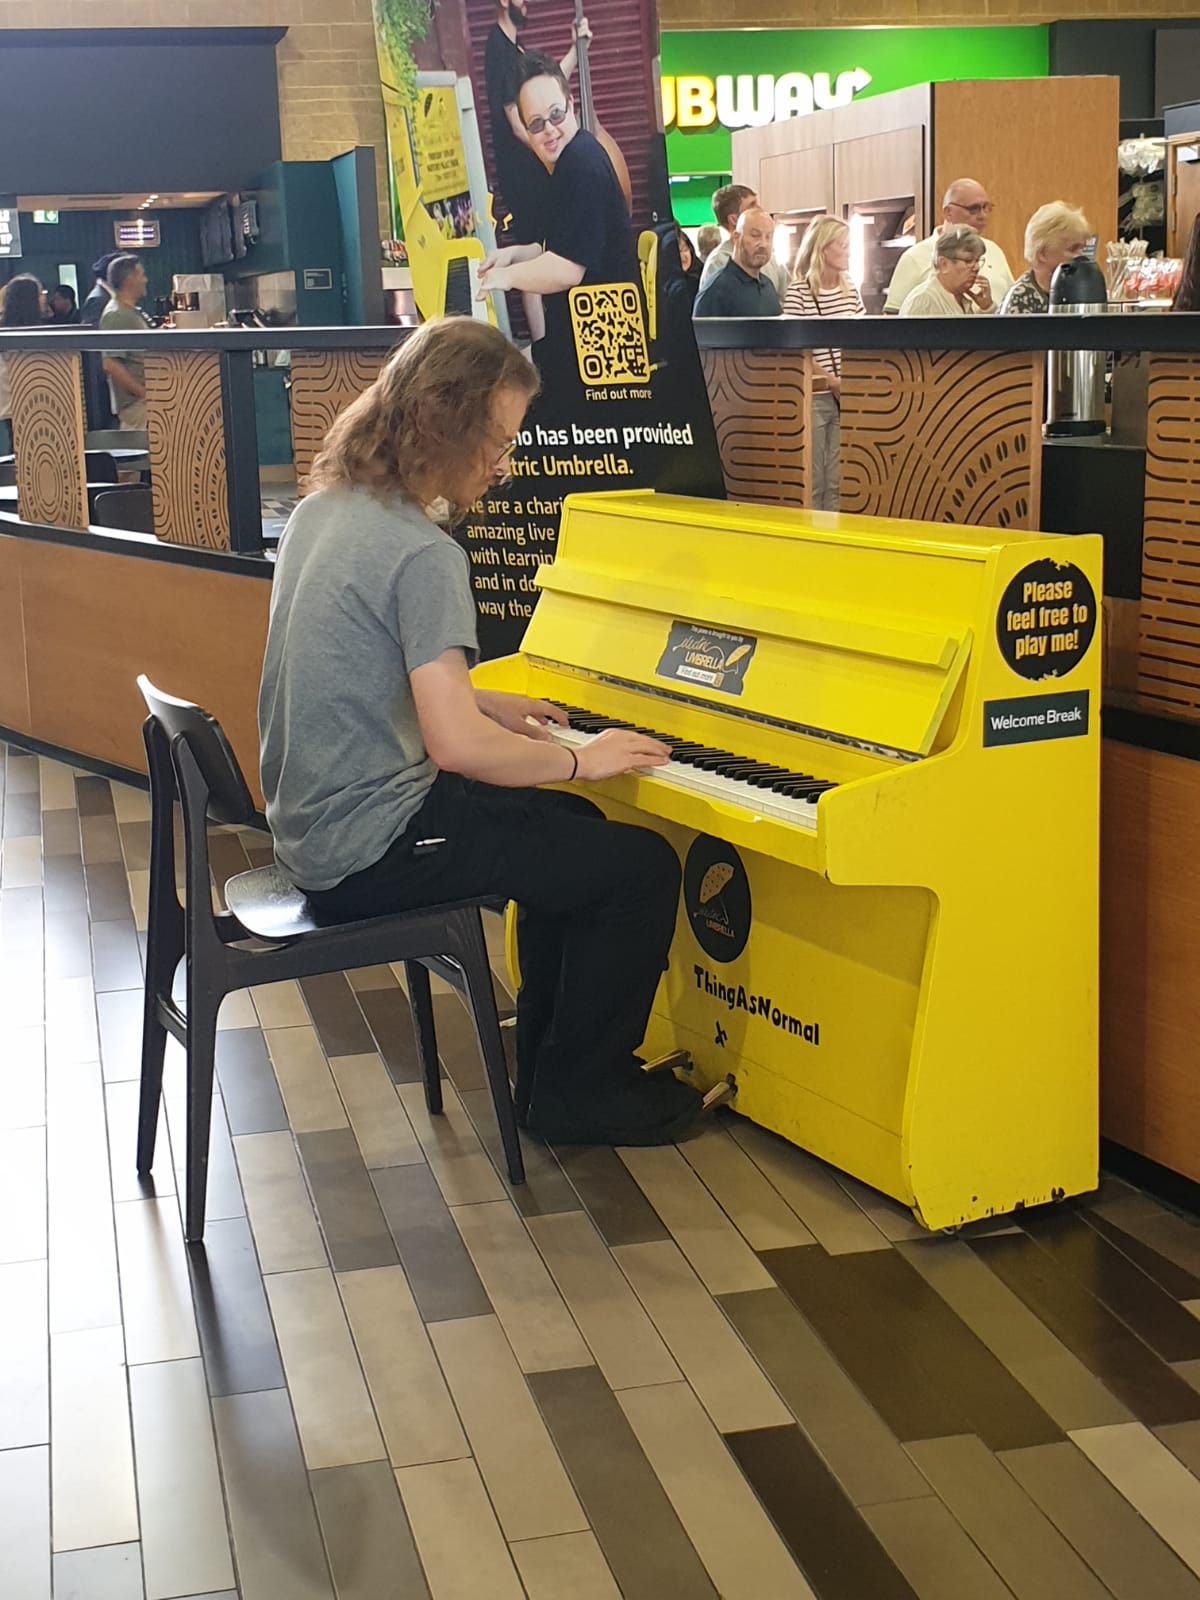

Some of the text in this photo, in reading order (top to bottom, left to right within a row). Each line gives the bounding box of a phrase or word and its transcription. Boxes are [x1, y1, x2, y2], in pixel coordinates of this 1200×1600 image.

[585, 388, 652, 400] Find out more
[535, 424, 568, 446] has
[571, 423, 618, 445] been
[623, 423, 694, 449] provided
[542, 453, 633, 477] Umbrella.
[488, 500, 510, 514] are
[514, 501, 523, 514] a
[467, 522, 555, 546] amazing live
[470, 547, 500, 565] with
[474, 573, 542, 592] and in do
[1023, 580, 1073, 603] Please
[478, 601, 505, 620] way
[1007, 603, 1088, 631] feel free to
[1015, 629, 1080, 660] play me!
[990, 707, 1082, 730] Welcome Break
